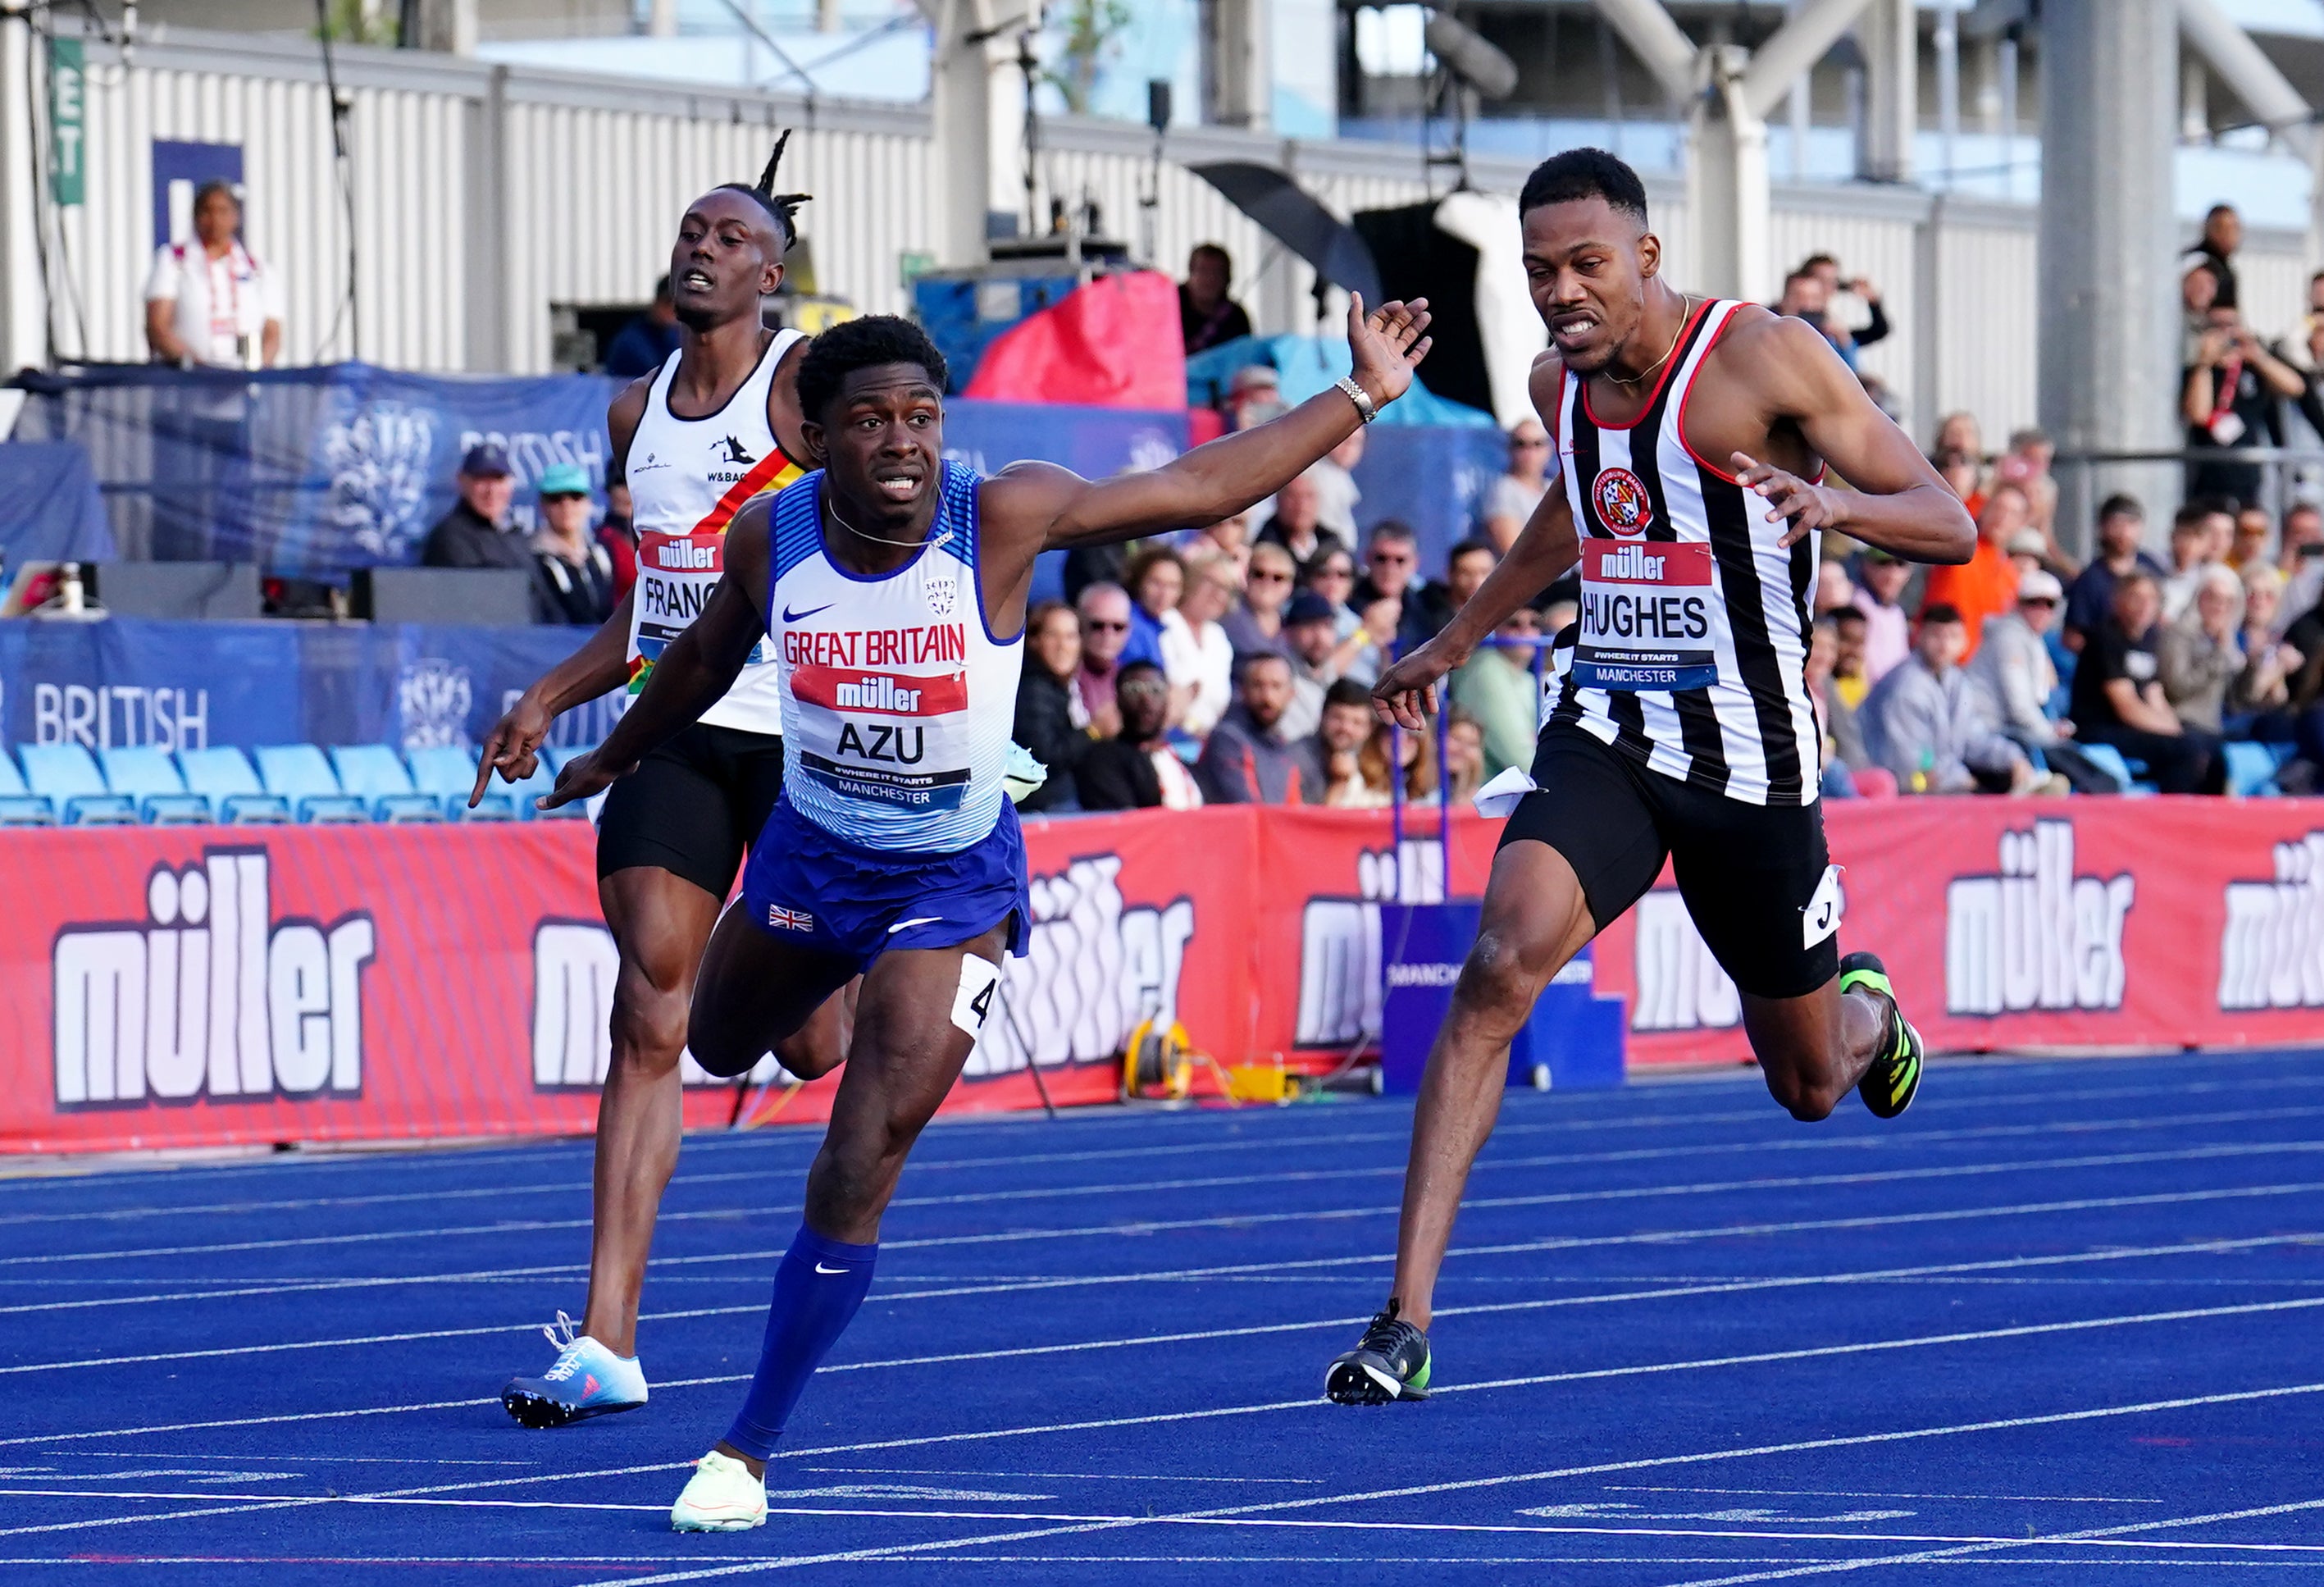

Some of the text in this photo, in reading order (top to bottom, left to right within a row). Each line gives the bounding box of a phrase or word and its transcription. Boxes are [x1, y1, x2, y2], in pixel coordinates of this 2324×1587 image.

[658, 539, 716, 569] müller
[1601, 545, 1666, 581] müller
[1584, 591, 1708, 640] HUGHES
[784, 623, 965, 667] GREAT BRITAIN
[1641, 654, 1679, 662] STARTS
[1596, 667, 1677, 683] MANCHESTER
[836, 677, 923, 713] müller
[35, 682, 208, 753] BRITISH
[836, 723, 924, 764] AZU
[835, 766, 880, 779] #WHERE
[891, 775, 934, 786] STARTS
[838, 780, 931, 805] MANCHESTER
[1947, 819, 2134, 1013] müller
[53, 848, 376, 1107] müller
[971, 978, 996, 1029] 4
